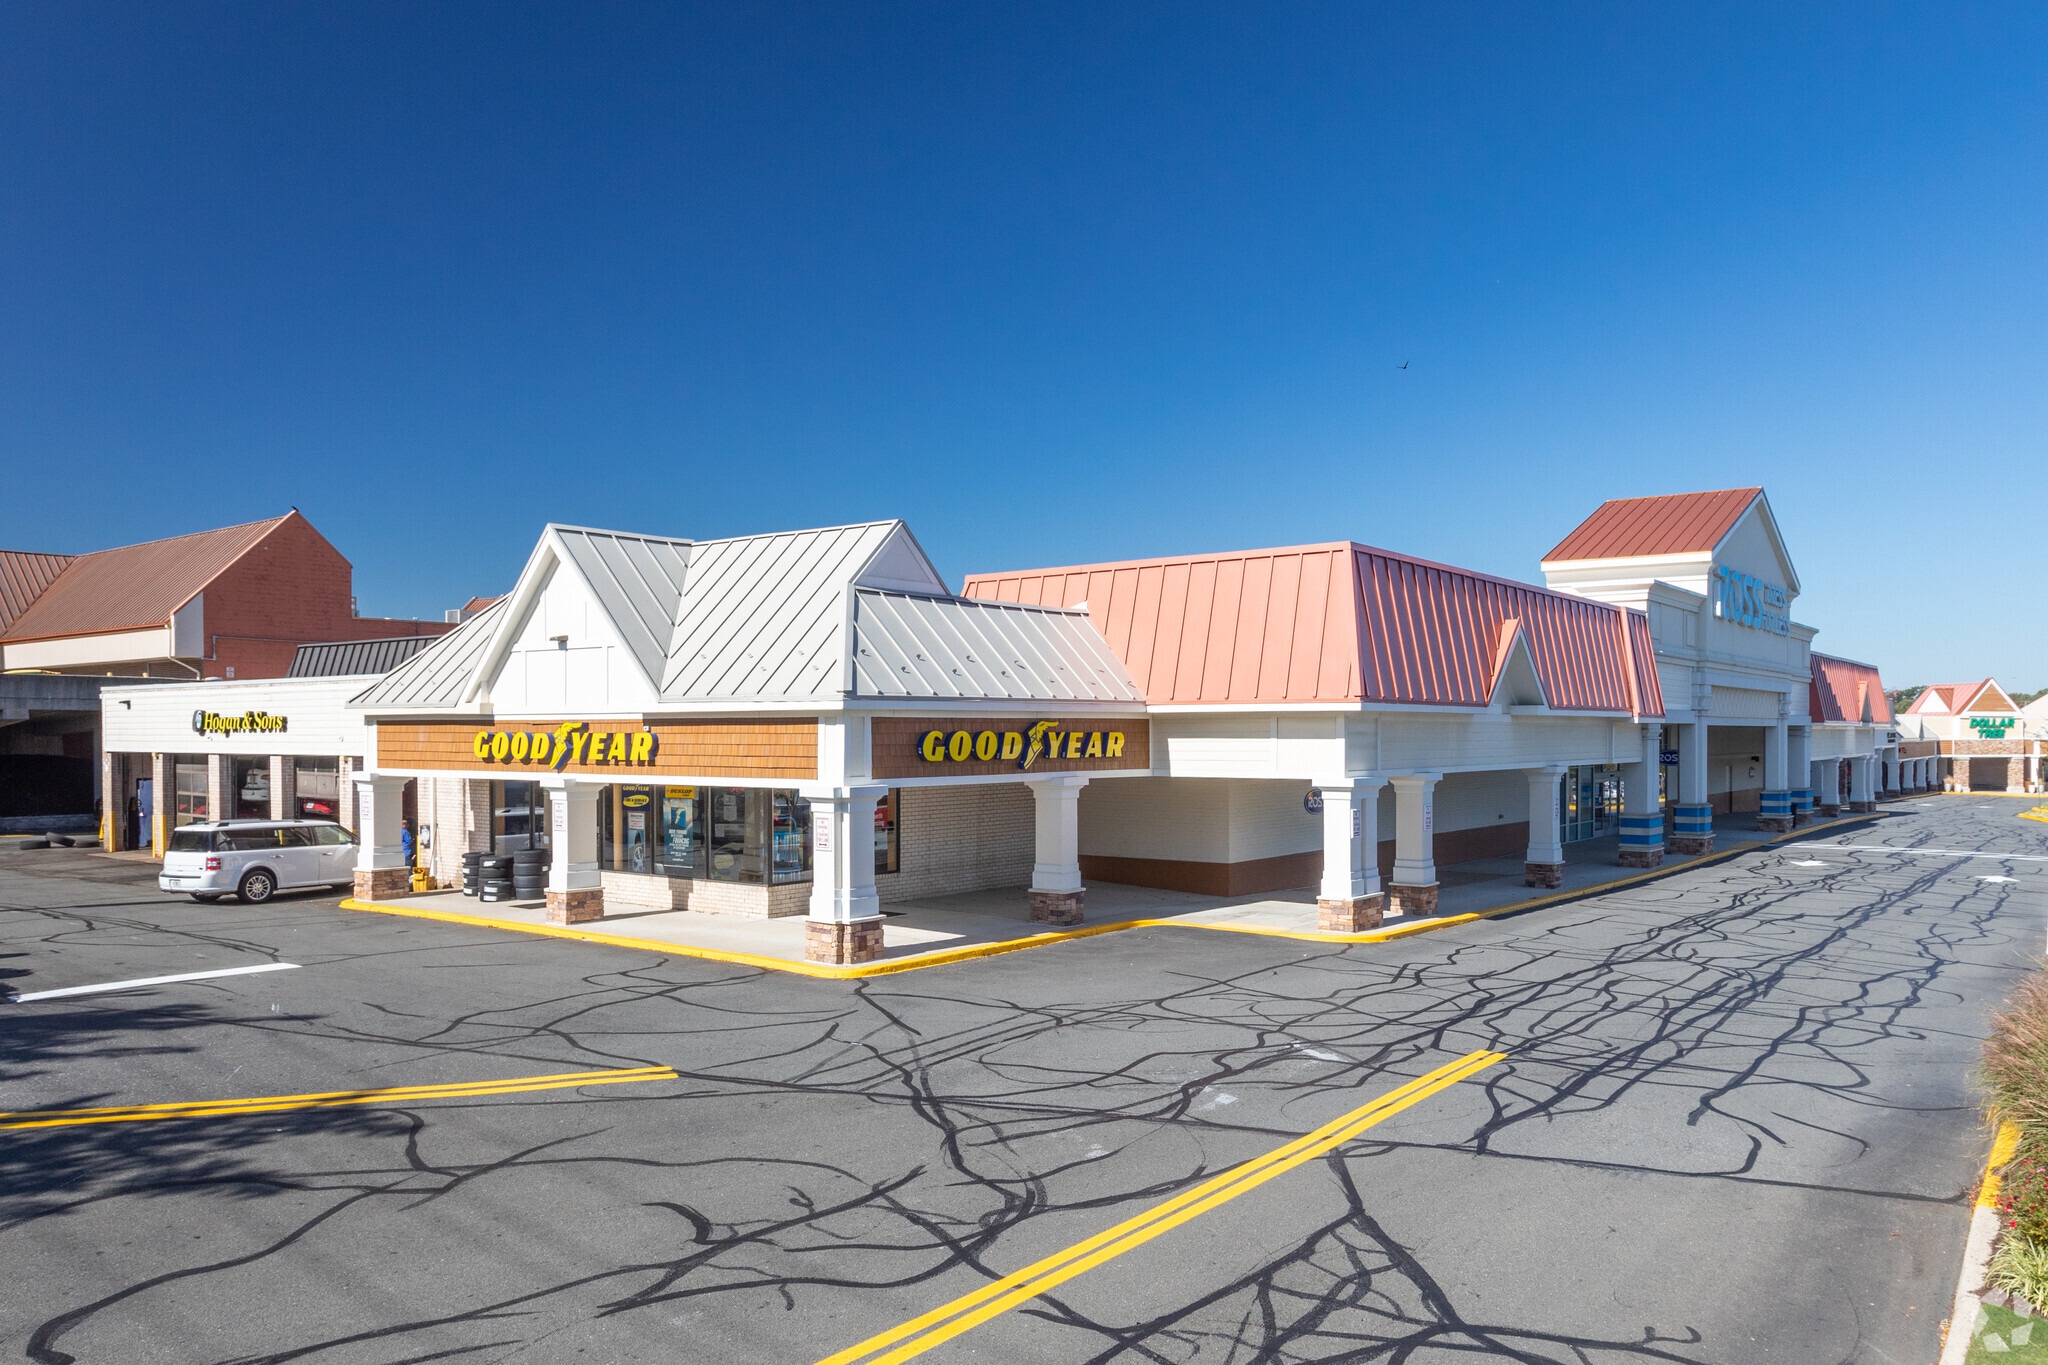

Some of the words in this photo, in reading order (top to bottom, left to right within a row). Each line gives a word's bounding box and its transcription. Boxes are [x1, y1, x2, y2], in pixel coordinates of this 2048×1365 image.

[1713, 565, 1763, 629] ROSS
[203, 711, 240, 734] Hogan
[241, 710, 253, 730] &
[253, 710, 284, 730] Sons
[1969, 717, 2015, 728] DOLLAR
[1978, 728, 2005, 739] TREE
[1660, 753, 1679, 762] ROS
[1308, 796, 1322, 808] ROS
